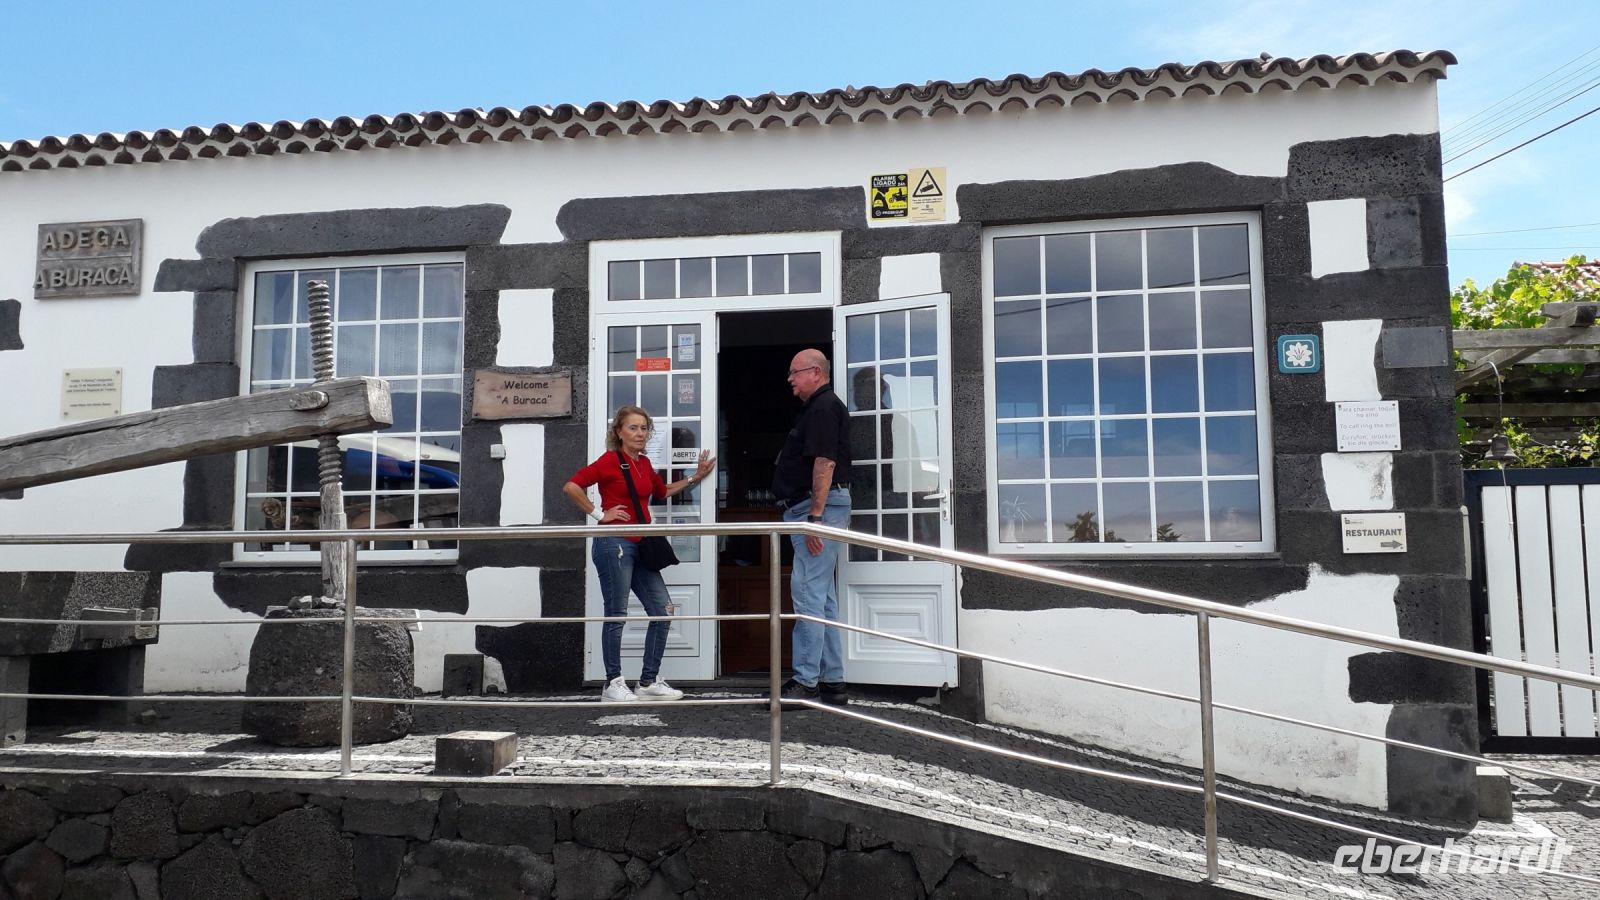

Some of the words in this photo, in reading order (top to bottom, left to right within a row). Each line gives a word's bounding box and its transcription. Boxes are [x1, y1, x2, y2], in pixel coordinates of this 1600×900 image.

[42, 227, 129, 250] ADEGA
[33, 269, 46, 288] A
[51, 263, 134, 288] BURACA
[504, 380, 549, 389] Welcome
[496, 395, 509, 405] "A
[513, 394, 552, 405] Buraca"
[1345, 528, 1403, 537] RESTAURANT
